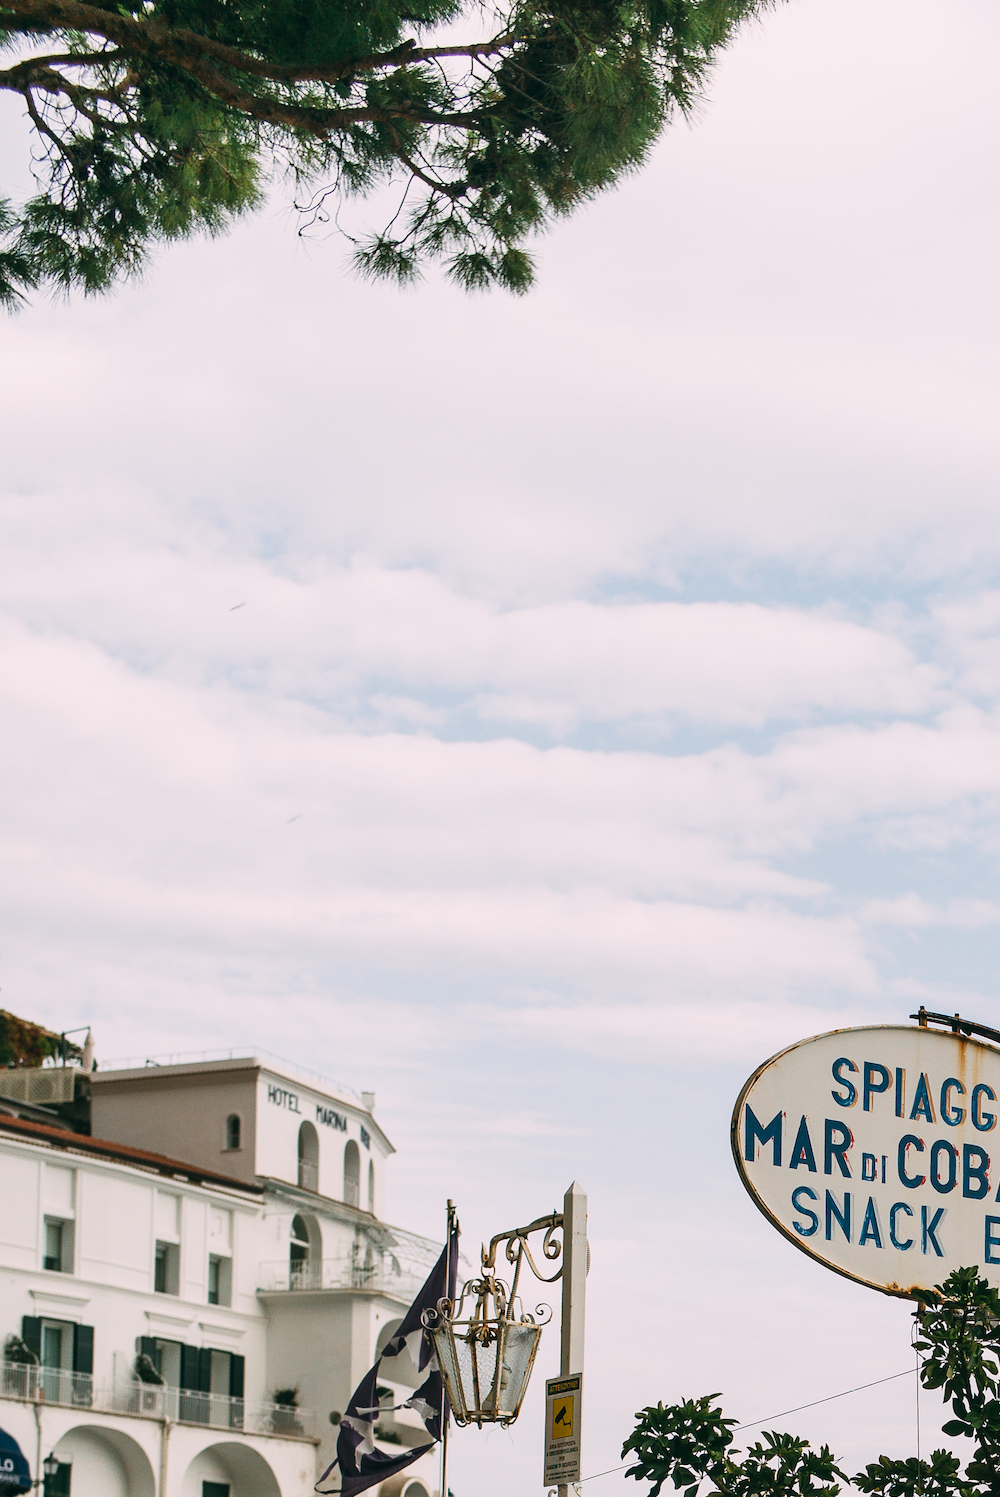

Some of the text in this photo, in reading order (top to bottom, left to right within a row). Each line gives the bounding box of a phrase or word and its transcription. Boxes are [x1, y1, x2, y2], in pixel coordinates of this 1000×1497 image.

[268, 1084, 302, 1115] HOTEL
[744, 1103, 854, 1178] MAR
[862, 1152, 886, 1184] DI
[791, 1186, 945, 1258] SNACK
